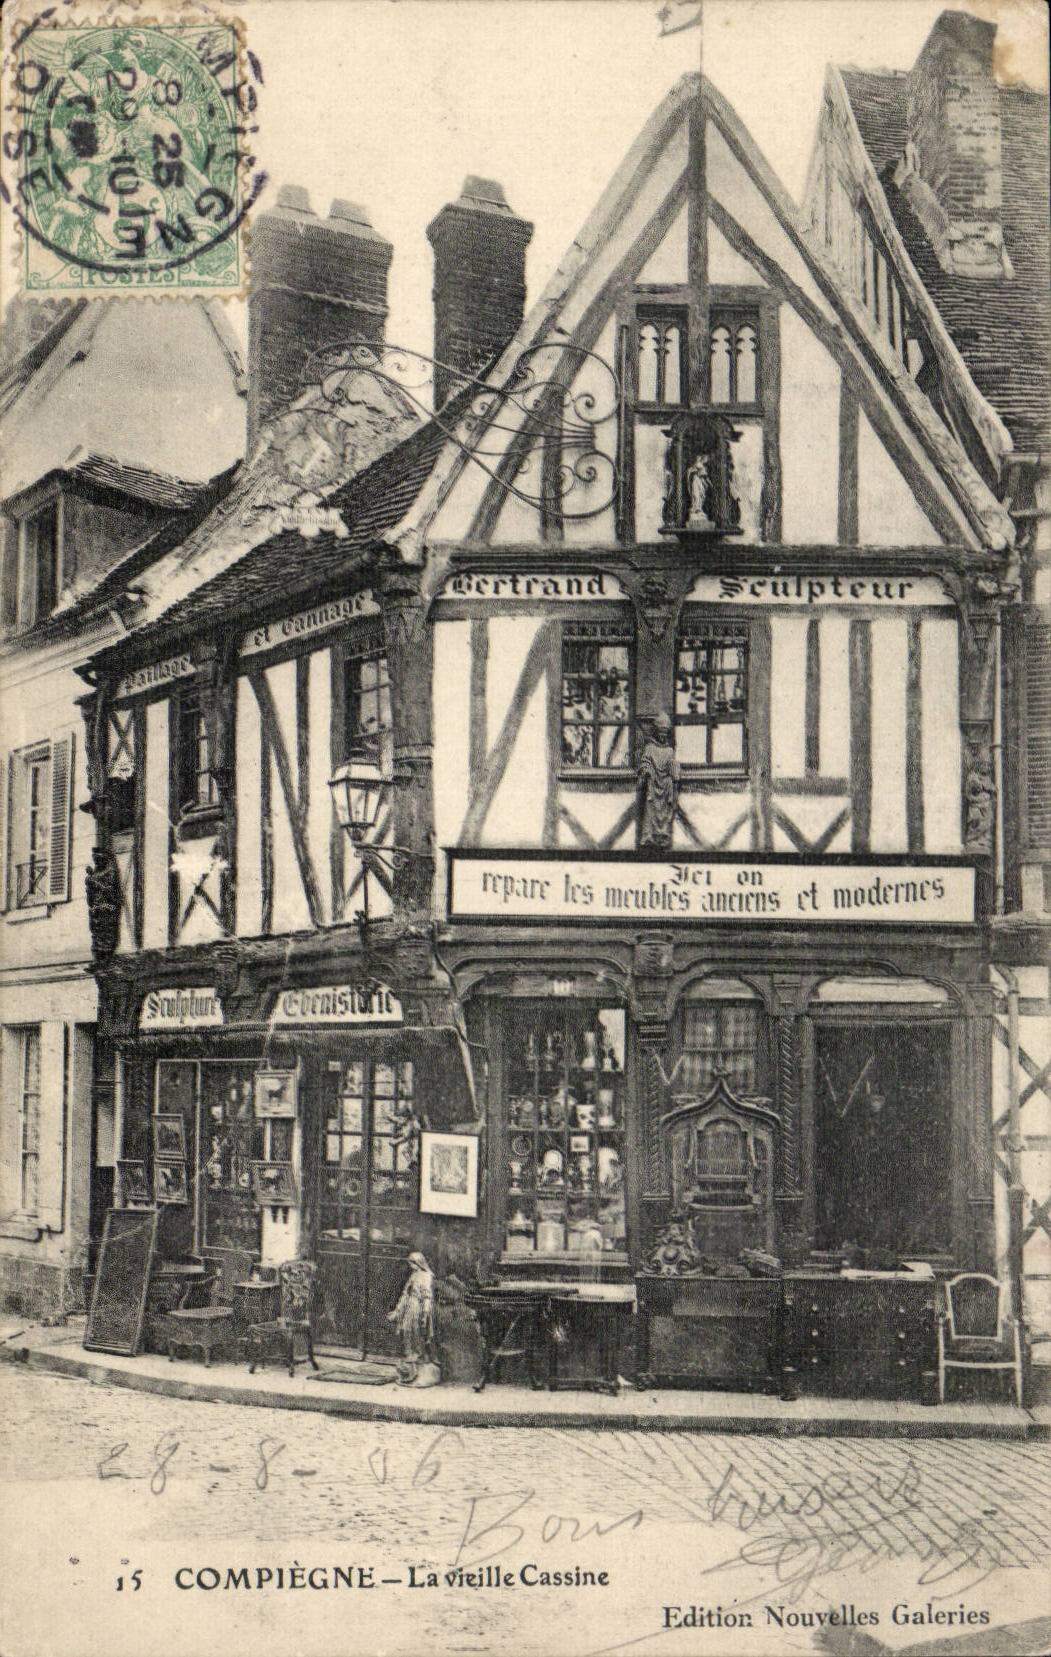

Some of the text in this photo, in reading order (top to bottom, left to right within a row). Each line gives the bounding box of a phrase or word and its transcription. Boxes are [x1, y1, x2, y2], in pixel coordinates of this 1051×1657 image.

[86, 263, 175, 285] POSTES
[452, 573, 606, 595] Bertrand
[718, 575, 913, 603] Sculpteur
[253, 625, 271, 648] et
[669, 864, 763, 887] Ici on
[482, 872, 946, 913] repare les meubles anciens et modernes
